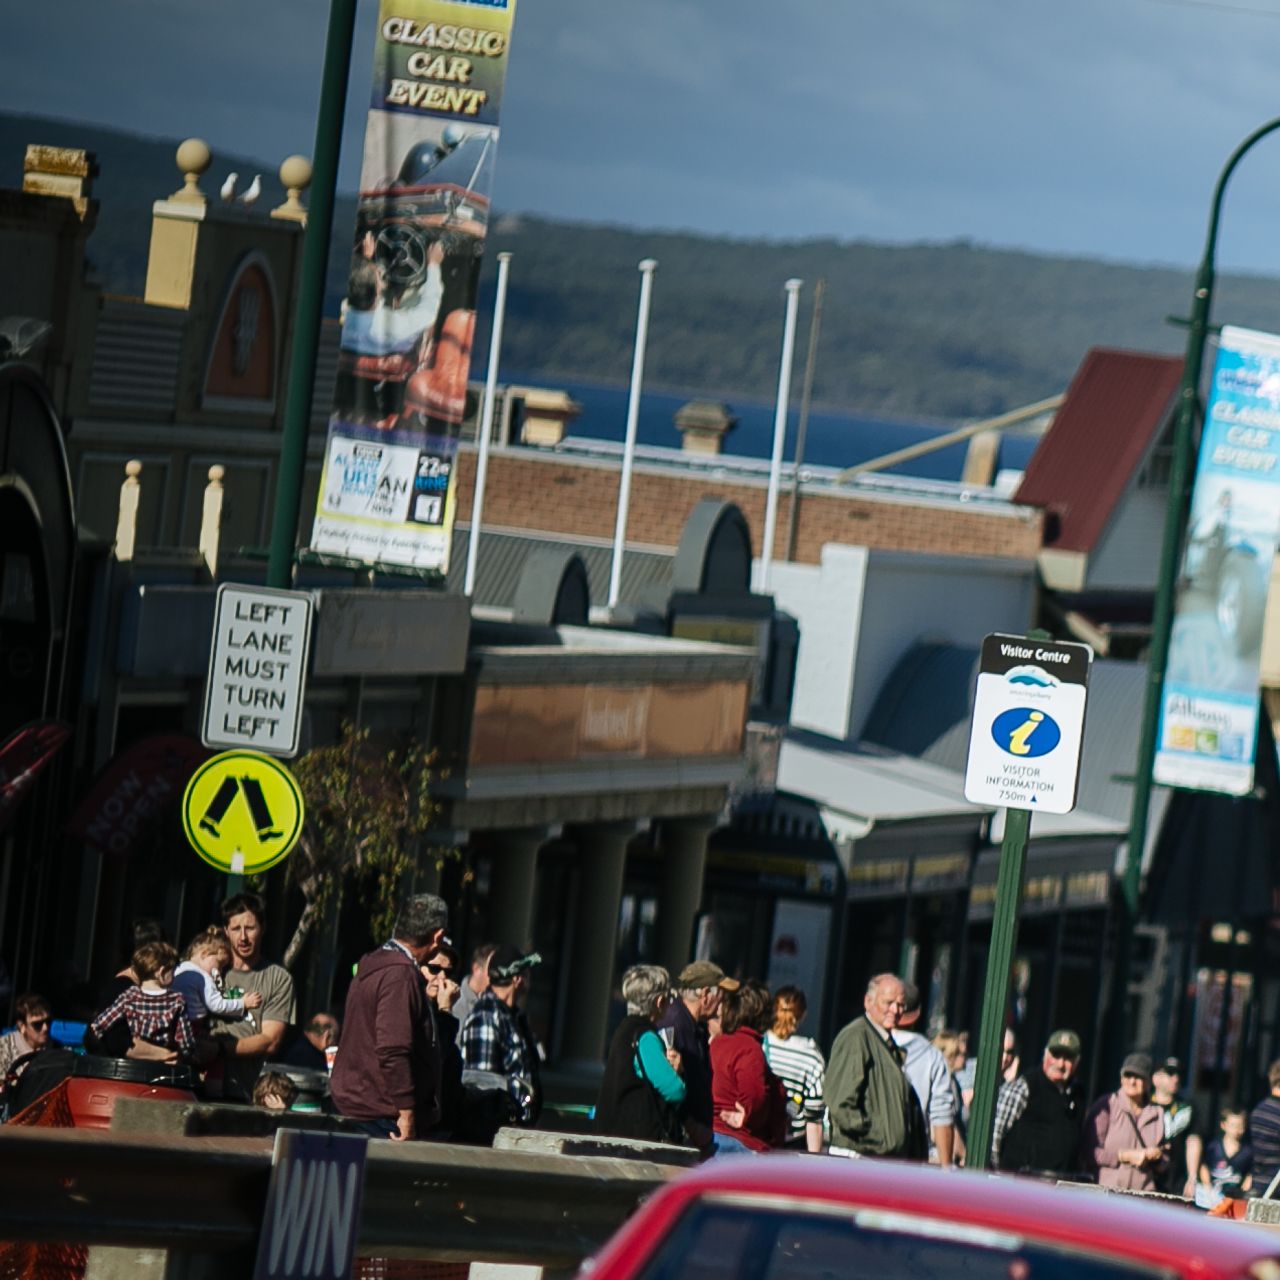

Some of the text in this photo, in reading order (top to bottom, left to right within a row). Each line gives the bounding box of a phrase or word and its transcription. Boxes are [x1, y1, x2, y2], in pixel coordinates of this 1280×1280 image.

[382, 17, 505, 57] CLASSIC
[407, 51, 474, 83] CAR
[385, 78, 488, 116] EVENT
[235, 600, 292, 626] LEFT
[228, 627, 293, 655] LANE
[1000, 643, 1071, 664] Visitor Centre
[225, 655, 290, 681] MUST
[224, 683, 286, 711] TURN
[223, 712, 280, 739] LEFT
[985, 775, 1054, 792] INFORMATION
[1002, 764, 1041, 777] VISITOR
[999, 790, 1027, 802] 750m
[268, 1157, 358, 1279] WIN
